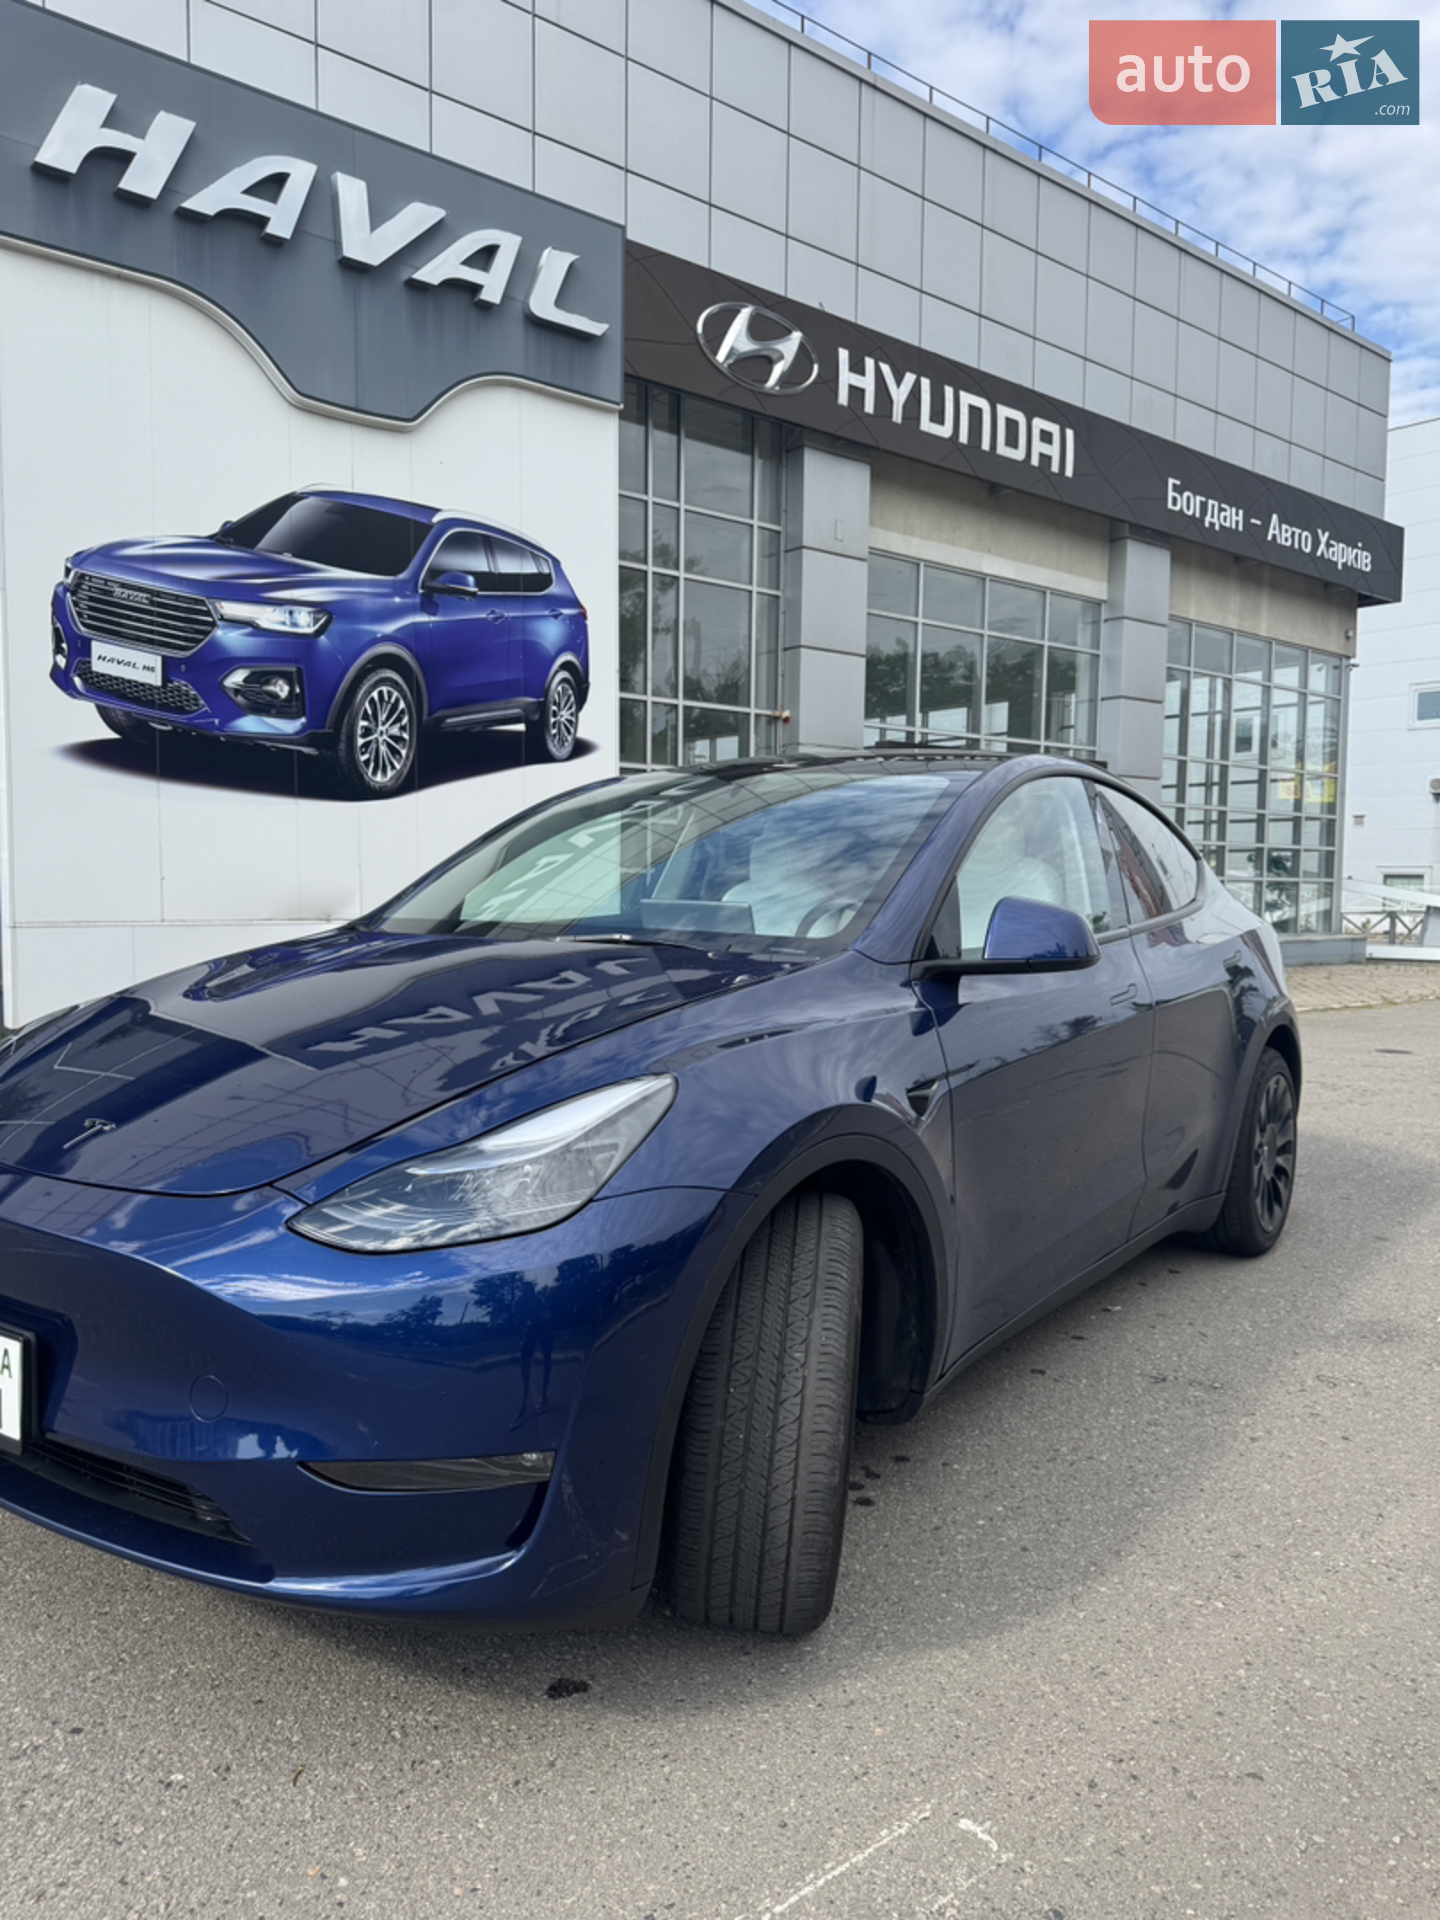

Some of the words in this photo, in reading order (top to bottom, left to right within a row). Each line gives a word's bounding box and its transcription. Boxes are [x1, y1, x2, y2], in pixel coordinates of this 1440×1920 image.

[33, 82, 610, 338] HAVAL
[837, 347, 1075, 478] HYUNDAI
[1167, 477, 1243, 532] Богдан
[1267, 513, 1312, 553] Авто
[1316, 528, 1372, 572] Харків
[97, 654, 139, 670] HAVAL
